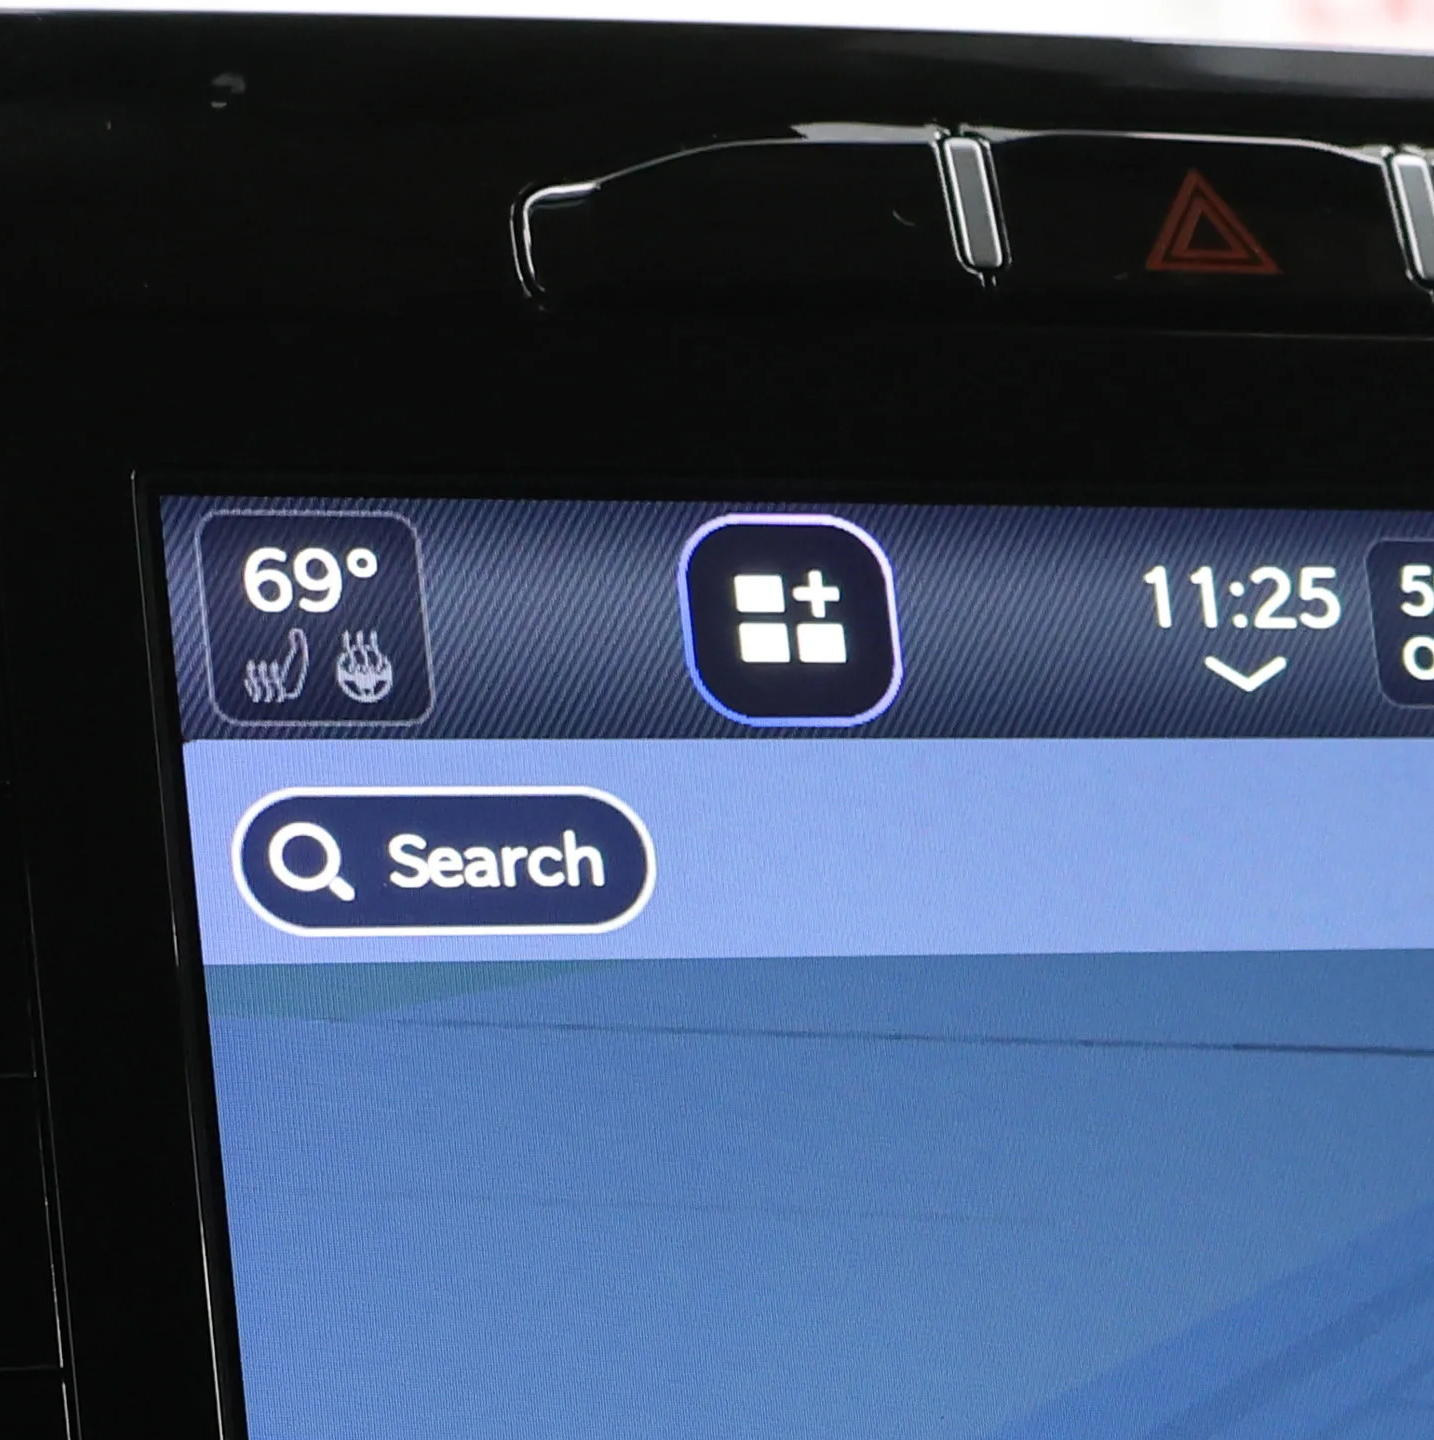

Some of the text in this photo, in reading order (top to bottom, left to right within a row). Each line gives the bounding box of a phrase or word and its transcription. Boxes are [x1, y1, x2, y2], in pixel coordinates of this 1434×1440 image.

[242, 545, 379, 614] 69°
[1142, 564, 1342, 631] 11:25
[387, 828, 606, 890] Search
